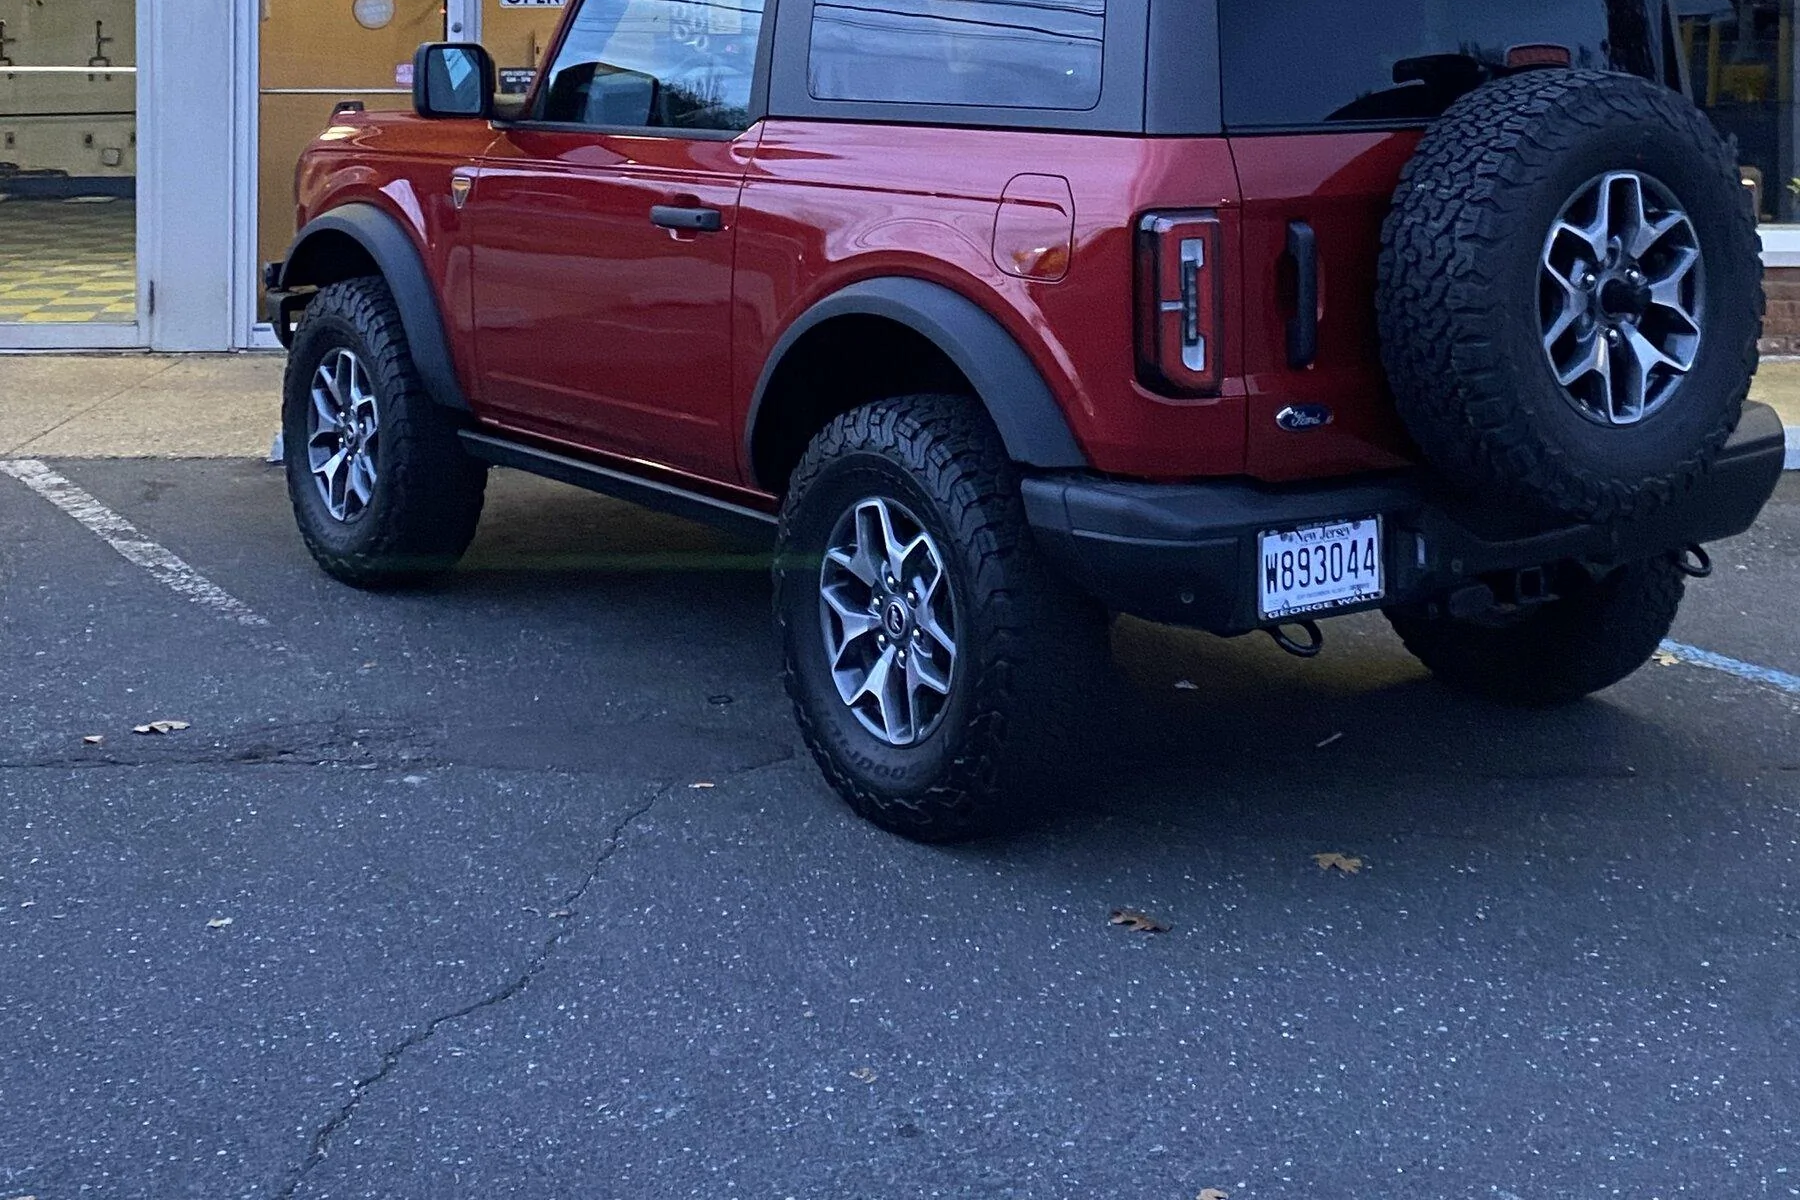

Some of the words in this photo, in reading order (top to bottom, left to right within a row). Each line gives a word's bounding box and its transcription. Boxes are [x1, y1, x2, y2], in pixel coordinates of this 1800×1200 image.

[1265, 537, 1376, 594] W893044
[1268, 601, 1334, 619] GEORGE
[1337, 593, 1380, 606] WALL
